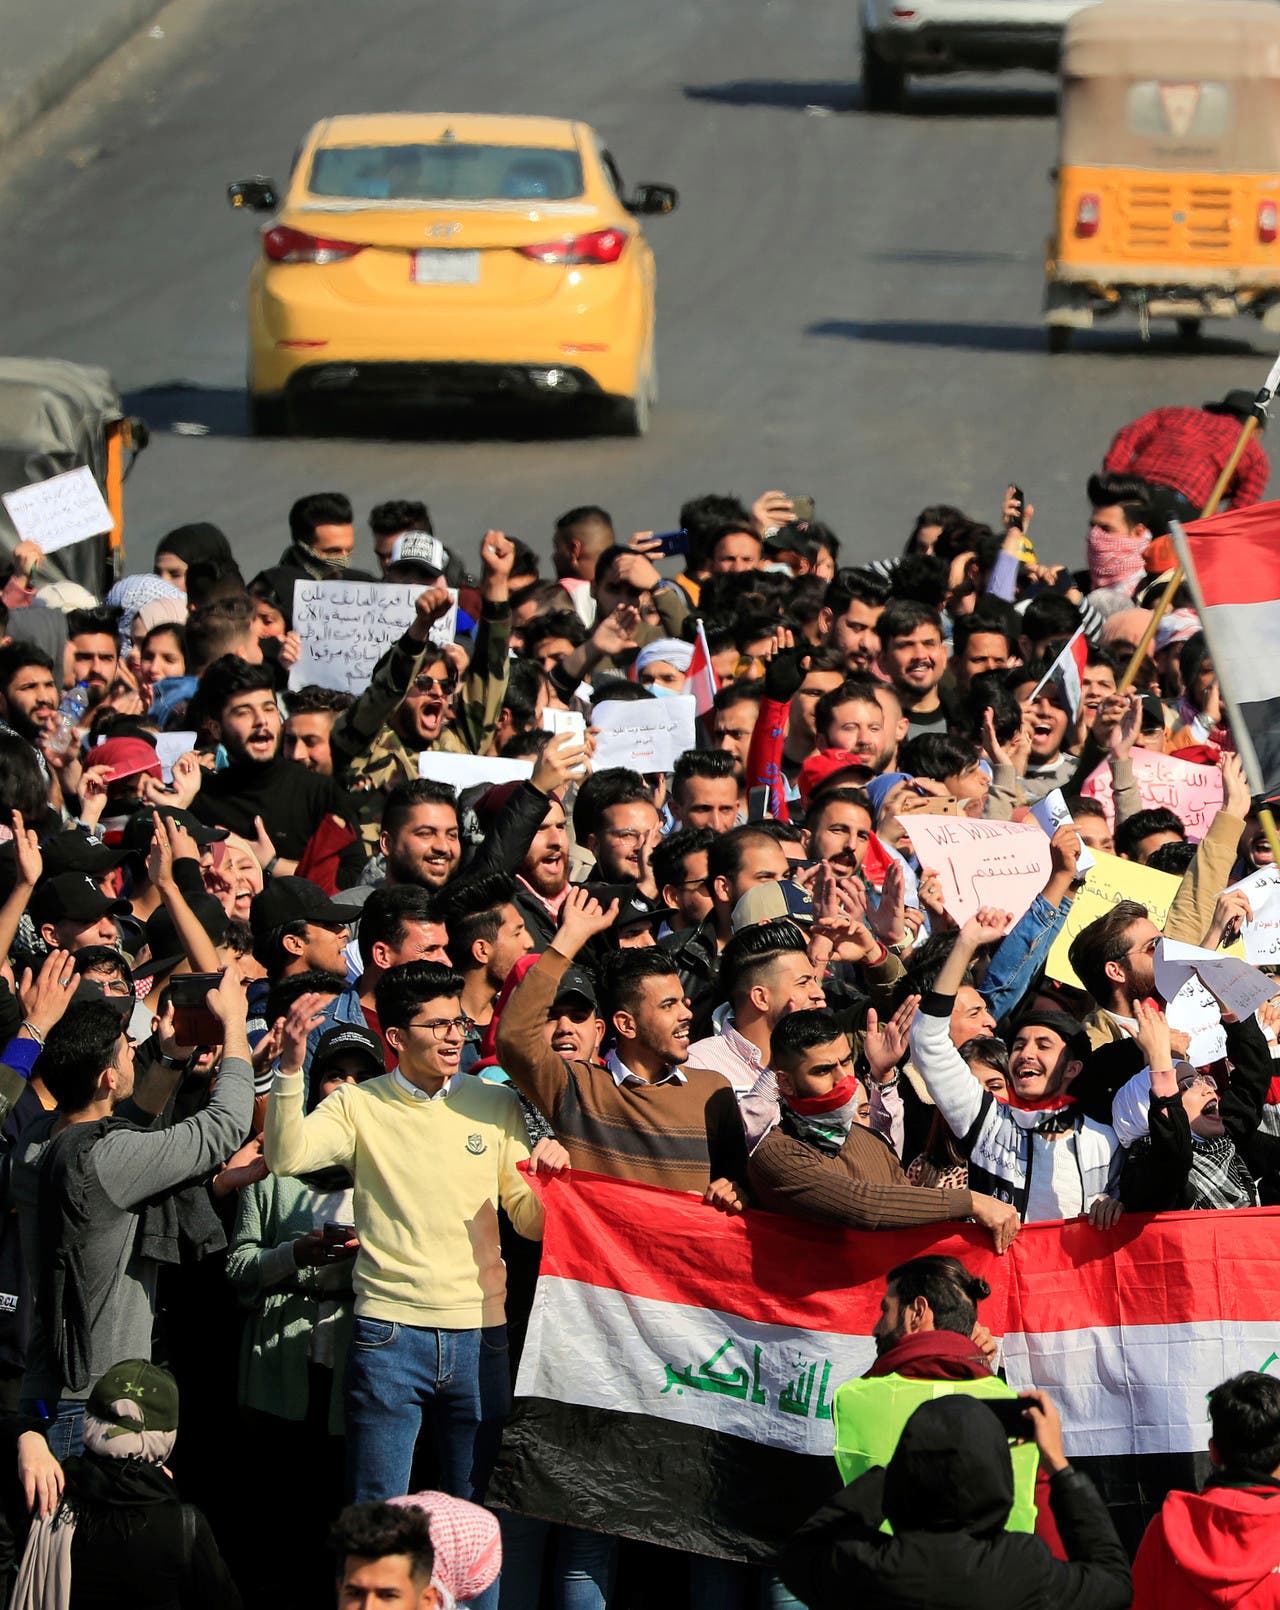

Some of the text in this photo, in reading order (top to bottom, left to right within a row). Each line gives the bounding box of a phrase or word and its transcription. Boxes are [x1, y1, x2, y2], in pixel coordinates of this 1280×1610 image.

[925, 823, 960, 847] WE
[660, 1338, 833, 1420] الله اكبر
